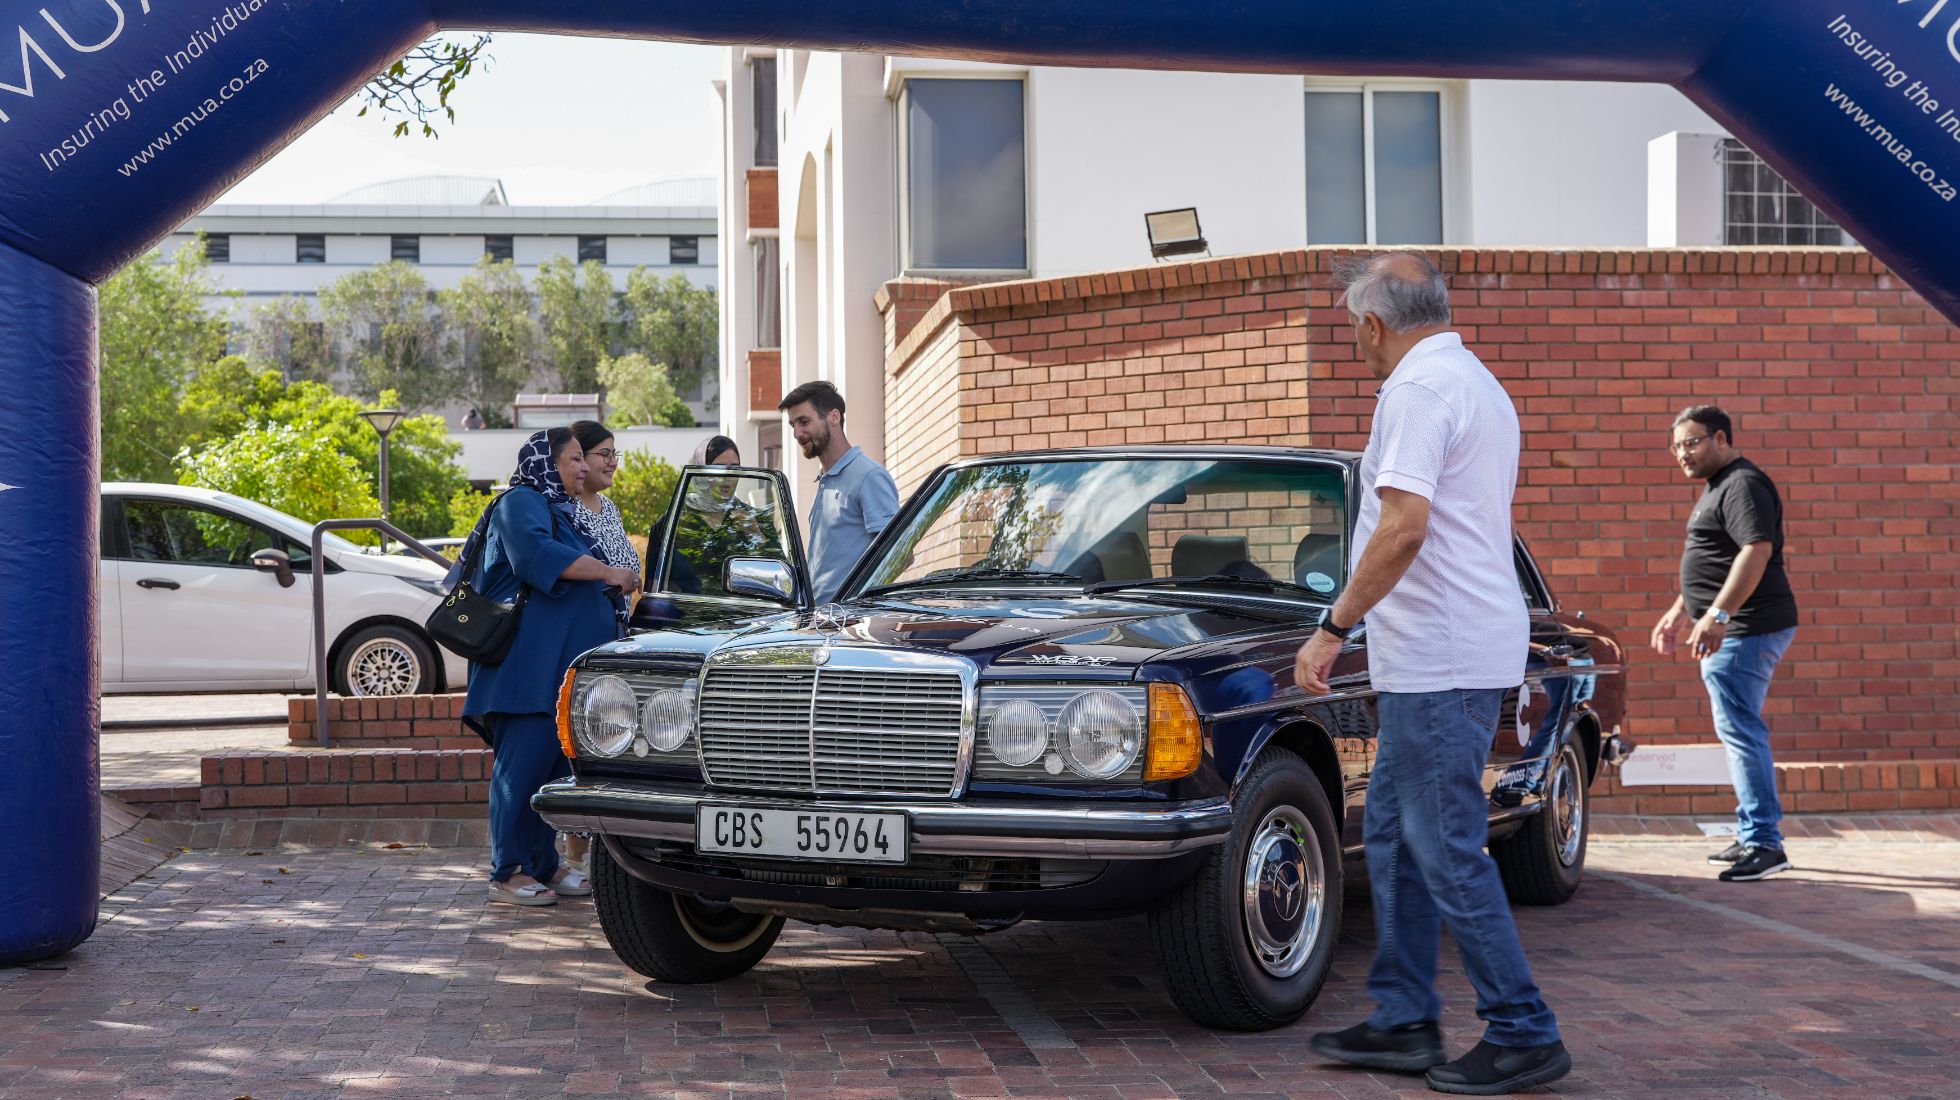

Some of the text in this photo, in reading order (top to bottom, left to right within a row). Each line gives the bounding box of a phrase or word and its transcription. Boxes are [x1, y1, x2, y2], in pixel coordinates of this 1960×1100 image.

[0, 0, 150, 123] MU
[40, 0, 268, 172] Insuring the Individua
[117, 58, 269, 177] www.mua.co.za
[1827, 14, 1908, 88] Insuring
[1903, 80, 1939, 114] the
[1824, 83, 1957, 201] www.mua.co.za
[1031, 654, 1117, 662] WRAP
[715, 811, 889, 855] CBS 55964
